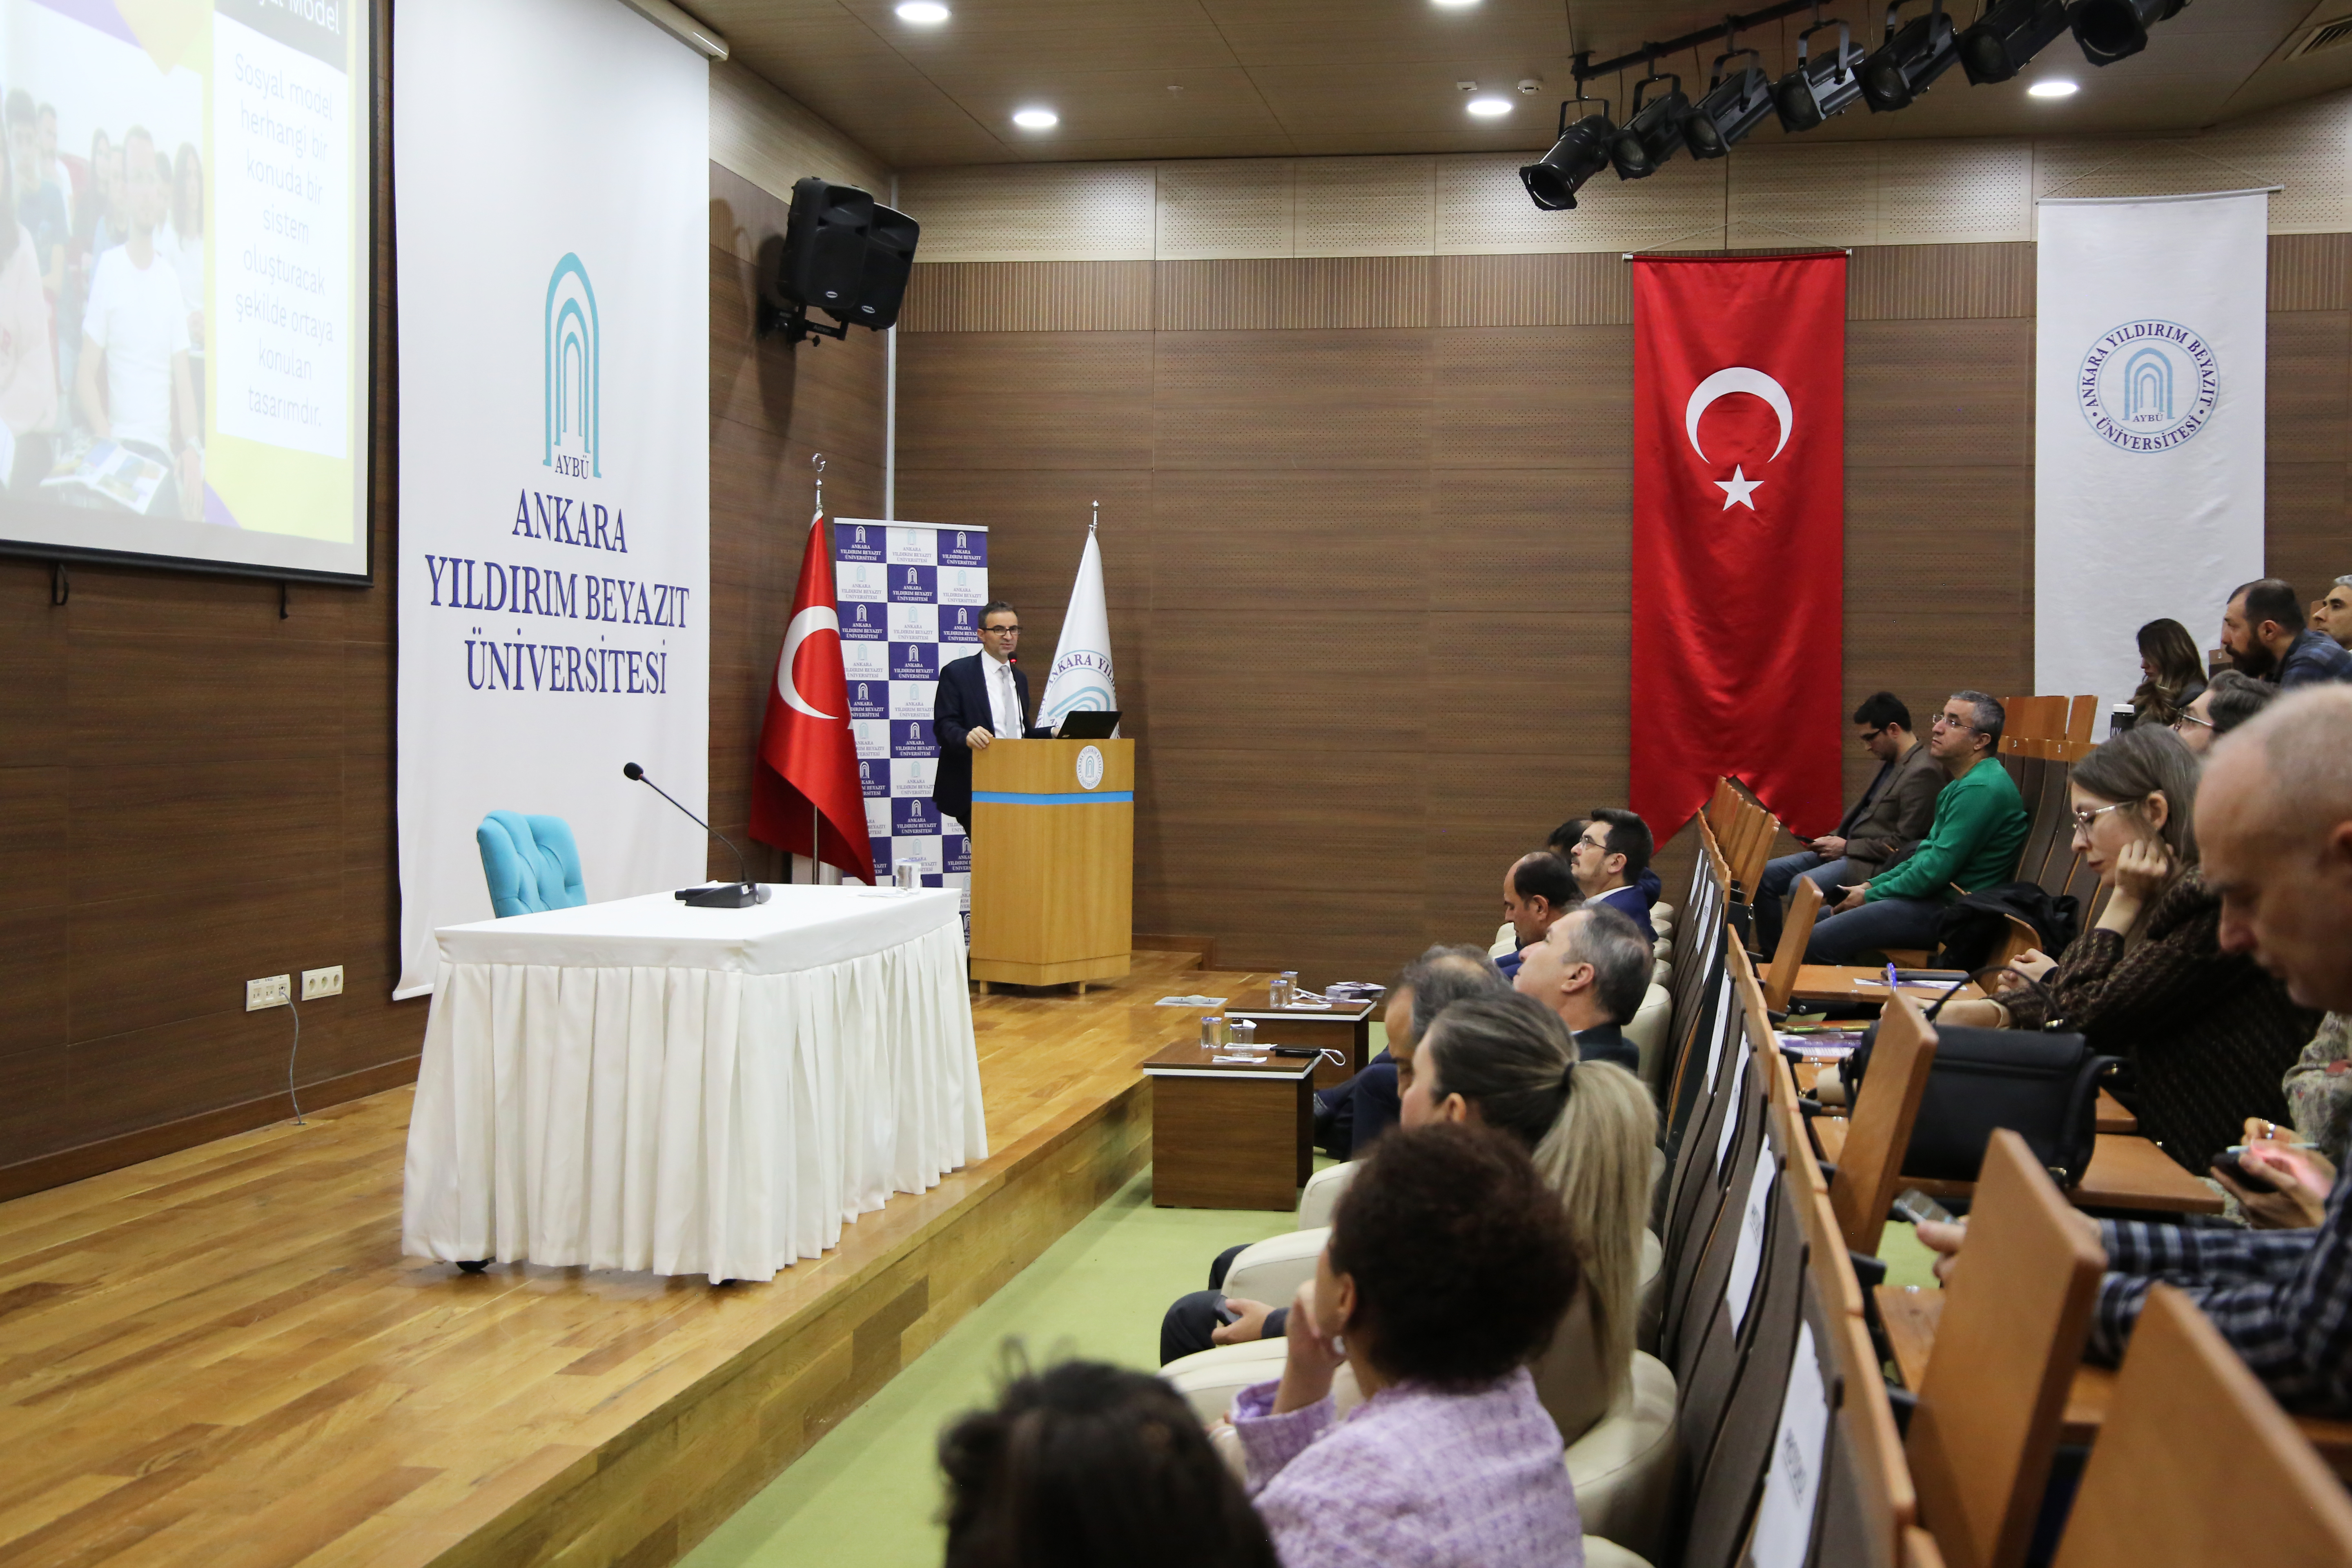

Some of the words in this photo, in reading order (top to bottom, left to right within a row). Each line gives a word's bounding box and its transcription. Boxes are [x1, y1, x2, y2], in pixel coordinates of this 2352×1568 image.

[236, 53, 284, 100] Sosyal
[290, 82, 332, 121] model
[241, 99, 306, 158] herhangi
[312, 128, 327, 161] bir
[247, 149, 302, 196] konuda
[307, 171, 323, 205] bir
[263, 204, 308, 244] sistem
[244, 242, 325, 296] oluşturacak
[236, 289, 287, 327] şekilde
[292, 311, 333, 346] ortaya
[259, 337, 311, 380] konulan
[2082, 347, 2109, 407] ANKARA
[2106, 323, 2189, 347] YILDIRIM
[2187, 340, 2216, 407] BEYAZIT
[249, 385, 321, 426] tasarımdır.
[2096, 415, 2202, 450] ÜNİVERSİTESİ
[2132, 412, 2164, 422] AYBÜ
[555, 454, 590, 479] AYBÜ
[512, 488, 628, 553] ANKARA
[425, 554, 578, 618] YILDIRIM
[585, 575, 690, 628] BEYAZIT
[465, 626, 667, 694] ÜNİVERSİTESİ
